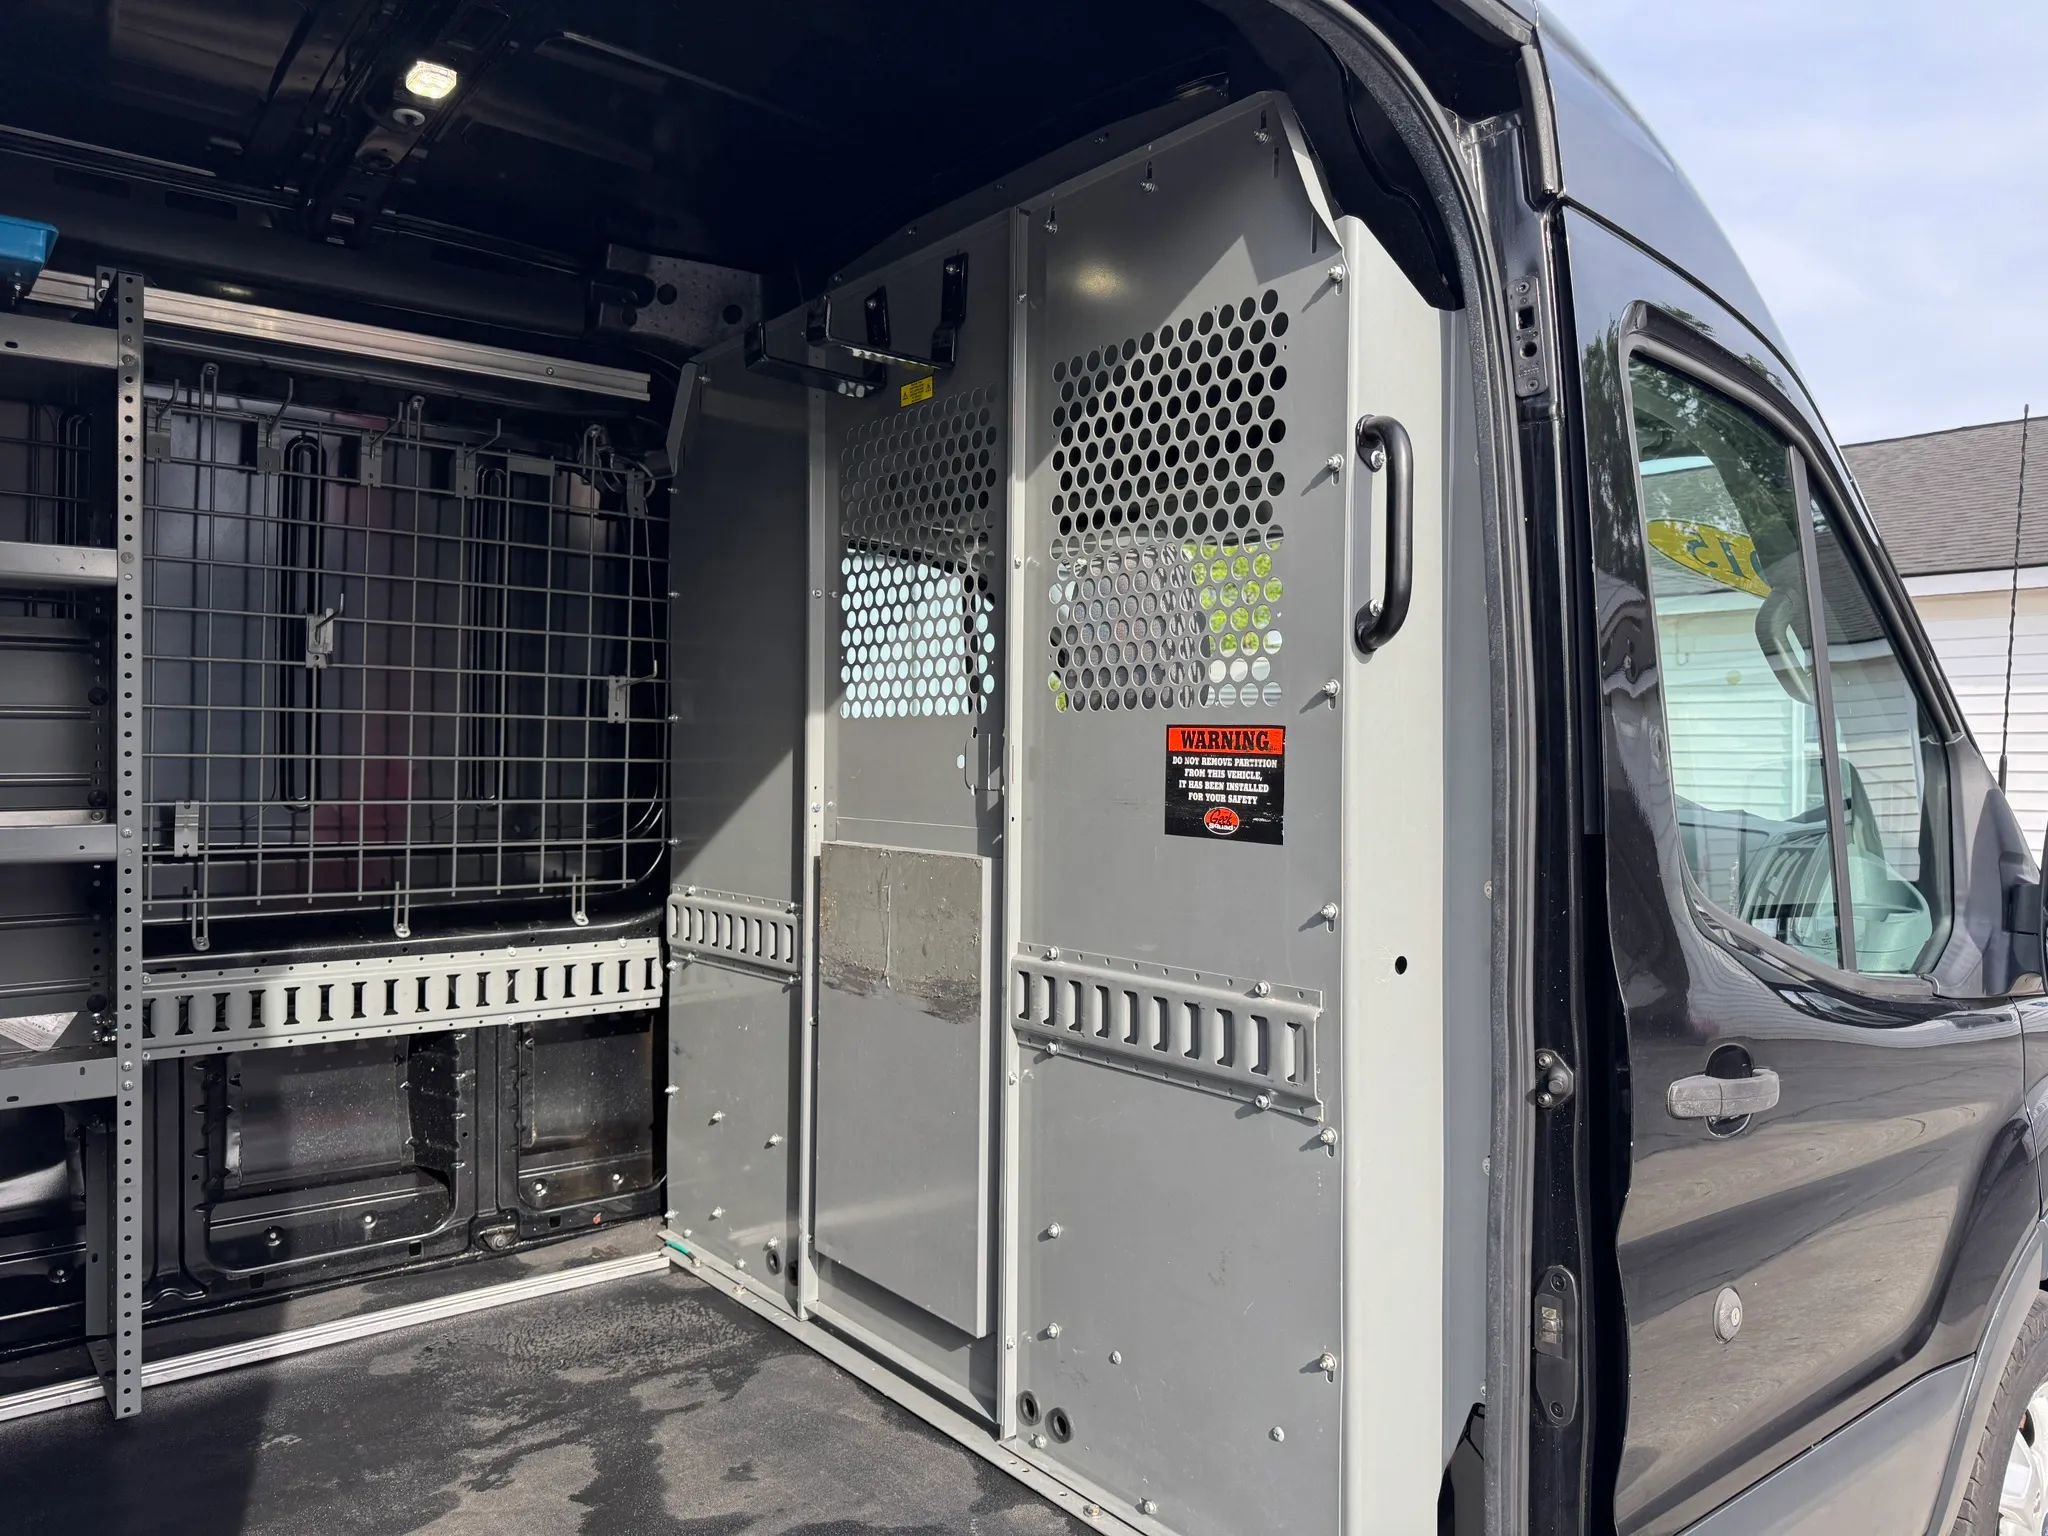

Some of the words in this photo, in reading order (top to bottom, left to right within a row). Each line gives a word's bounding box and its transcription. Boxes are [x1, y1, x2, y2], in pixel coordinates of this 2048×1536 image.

[1181, 730, 1270, 752] WARNING
[1172, 756, 1182, 765] DO
[1184, 756, 1199, 766] NOT
[1201, 757, 1232, 767] REMOVE
[1234, 758, 1278, 769] PARTITION
[1184, 768, 1206, 778] FROM
[1207, 769, 1226, 779] THIS
[1227, 770, 1263, 781] VEHICLE,
[1179, 780, 1187, 789] IT
[1188, 780, 1203, 790] HAS
[1204, 781, 1225, 791] BEEN
[1226, 782, 1270, 793] INSTALLED
[1188, 792, 1204, 802] FOR
[1205, 793, 1227, 803] YOUR
[1228, 794, 1258, 805] SAFETY
